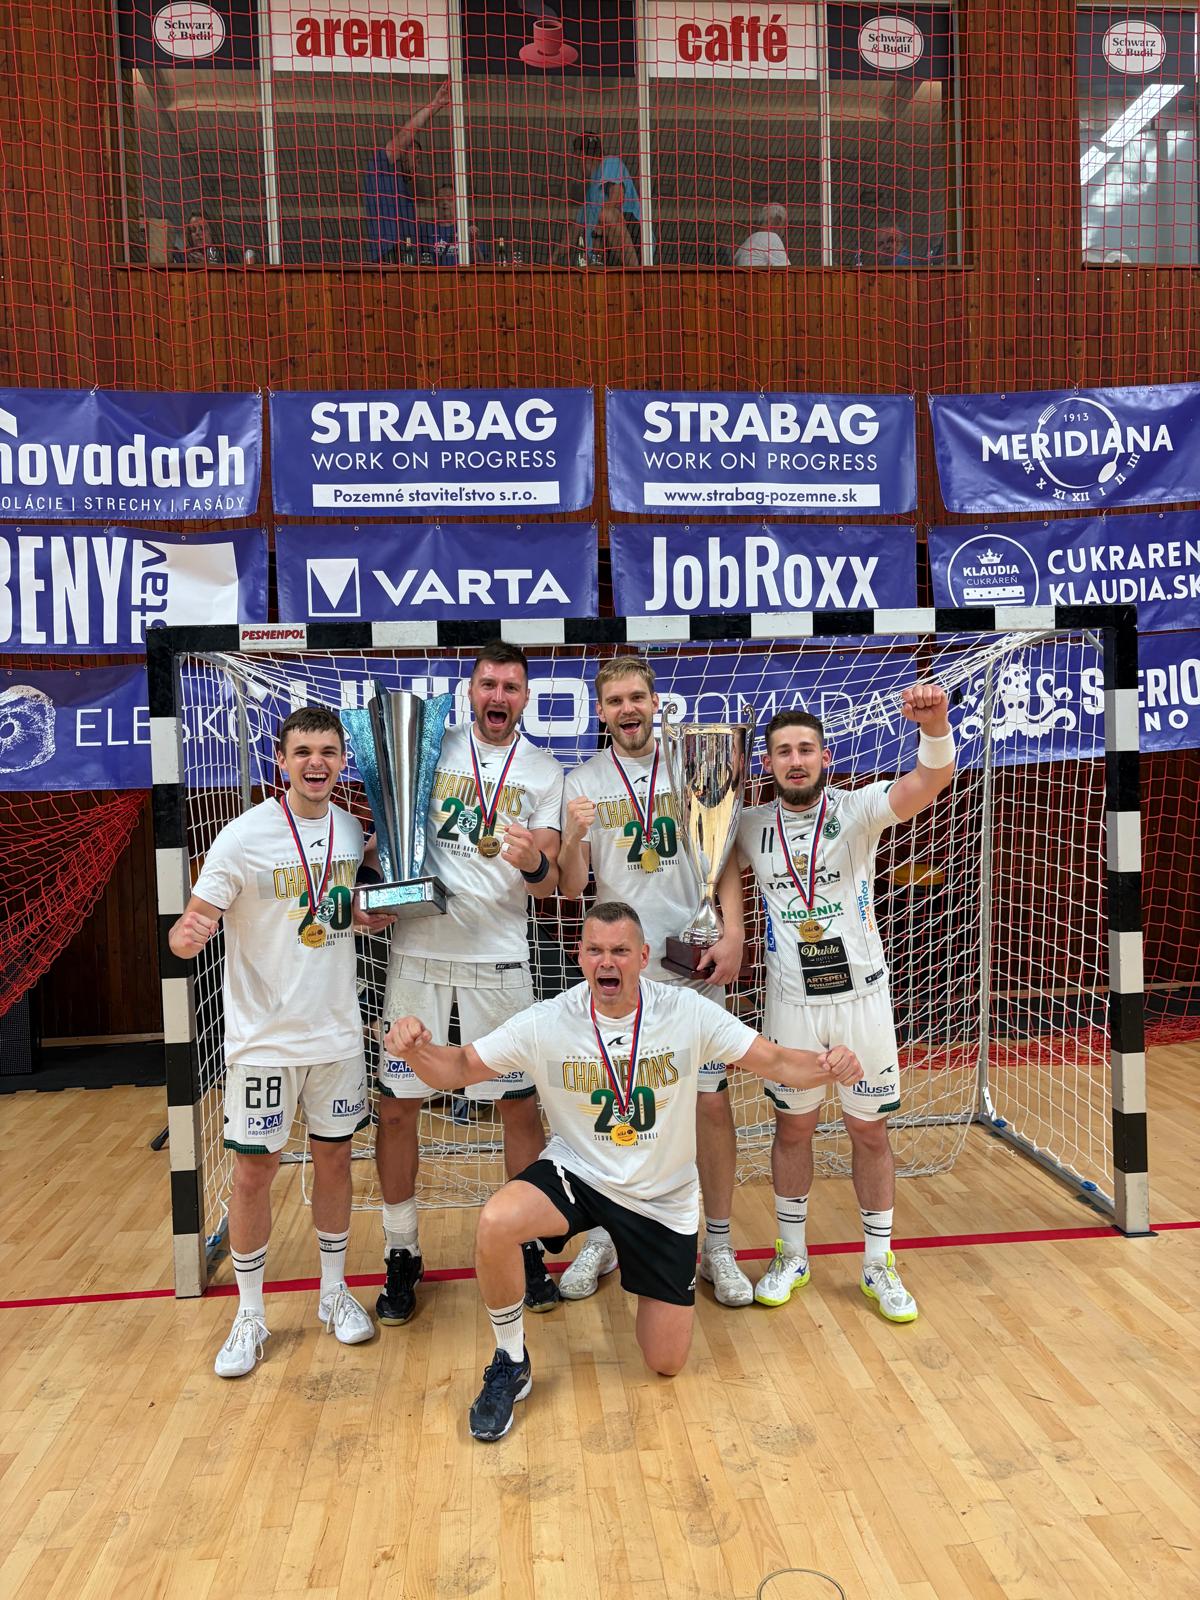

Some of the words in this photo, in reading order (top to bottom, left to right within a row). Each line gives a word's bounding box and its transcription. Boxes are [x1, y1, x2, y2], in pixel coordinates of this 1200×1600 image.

[164, 20, 214, 30] Schwarz
[168, 31, 177, 40] &
[180, 31, 211, 41] Budil
[296, 17, 424, 58] arena
[678, 14, 787, 62] caffé
[868, 34, 913, 43] Schwarz
[1112, 38, 1156, 47] Schwarz
[871, 44, 879, 52] &
[883, 44, 911, 53] Budil
[1115, 48, 1123, 56] &
[1126, 48, 1153, 57] Budil
[311, 398, 557, 443] STRABAG
[643, 401, 880, 445] STRABAG
[1063, 413, 1090, 422] 1913
[981, 424, 1174, 462] MERIDIANA
[312, 453, 383, 470] WORK
[392, 452, 429, 469] ON
[441, 450, 557, 468] PROGRESS
[644, 451, 712, 469] WORK
[720, 452, 756, 469] ON
[767, 453, 878, 471] PROGRESS
[333, 488, 405, 503] Pozemné
[408, 486, 496, 502] staviteľstvo
[499, 490, 538, 501] s.r.o.
[664, 487, 858, 504] www.strabag-pozemne.sk
[1036, 477, 1047, 490] X
[1053, 488, 1066, 500] XI
[1072, 492, 1091, 502] XII
[85, 496, 162, 511] STRECHY
[184, 495, 244, 511] FASÁDY
[645, 536, 880, 611] JobRoxx
[963, 564, 1020, 577] KLAUDIA
[372, 569, 571, 605] VARTA
[1049, 574, 1200, 605] KLAUDIA.SK
[241, 629, 304, 641] PESMENPOL
[623, 816, 678, 863] 20
[766, 871, 841, 890] TATAN
[781, 902, 844, 919] PHOENIX
[801, 944, 840, 958] Dukla
[807, 973, 849, 984] ARTSPELL
[245, 1077, 282, 1108] 28
[591, 1086, 657, 1133] 20
